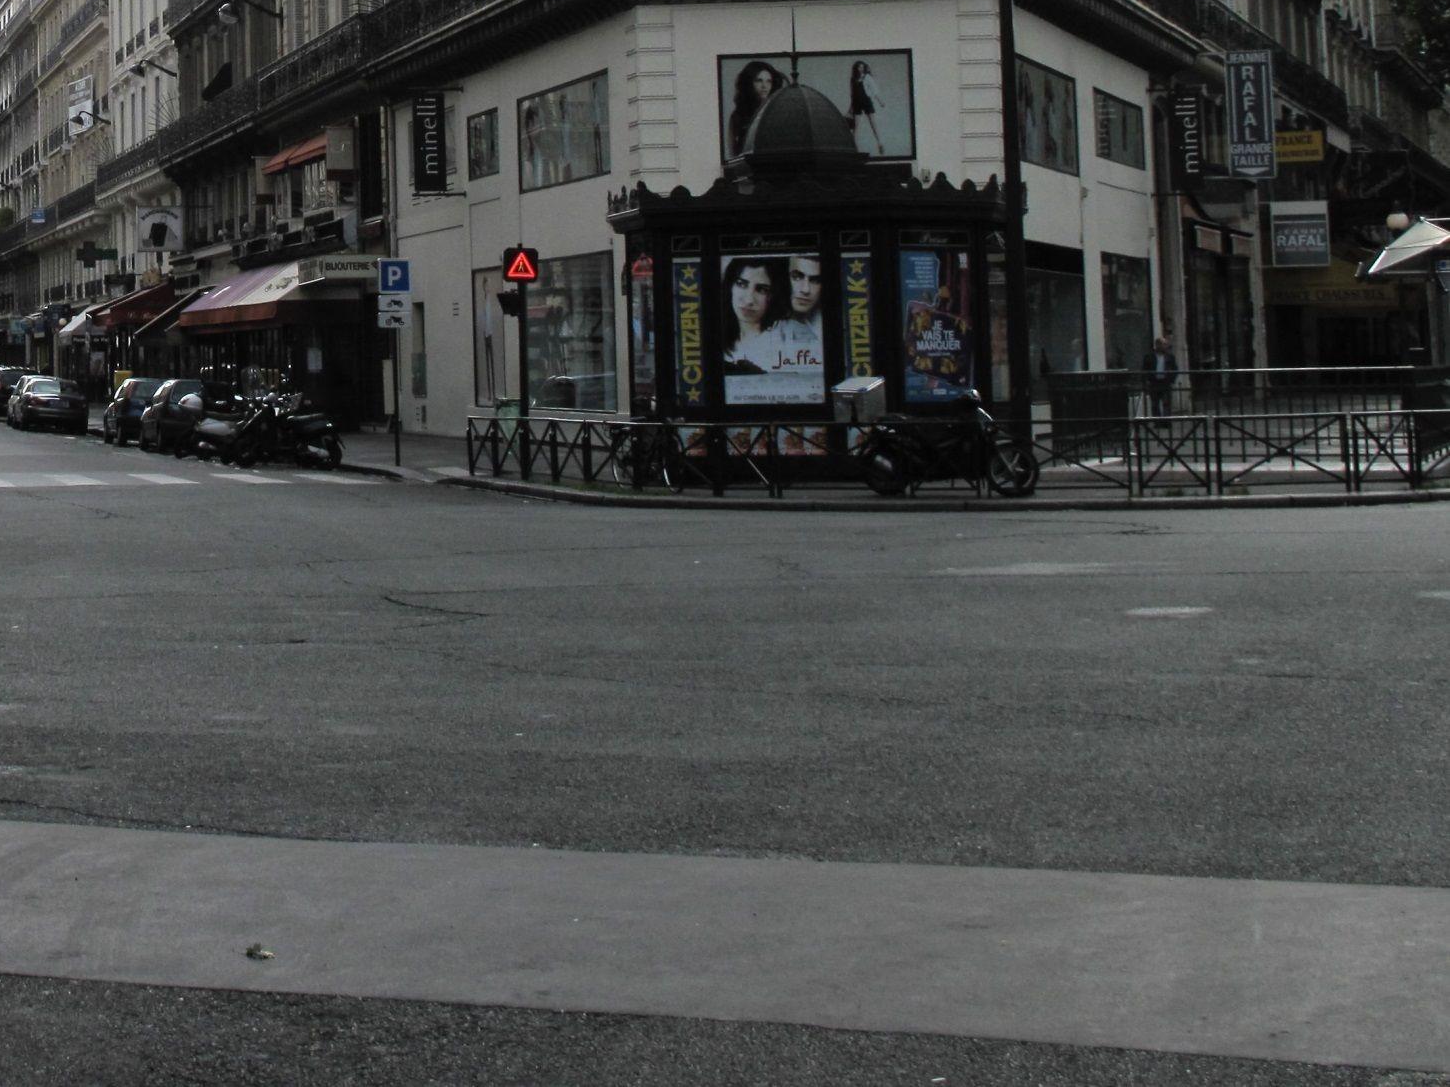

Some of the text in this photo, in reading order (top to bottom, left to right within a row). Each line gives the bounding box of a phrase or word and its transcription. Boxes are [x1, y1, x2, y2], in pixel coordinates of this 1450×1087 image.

[1227, 53, 1268, 64] JEANNE
[1241, 65, 1257, 142] RAFAL
[416, 98, 438, 174] minelli
[1174, 97, 1200, 173] minelli
[1230, 143, 1272, 154] GRANDE
[1232, 154, 1271, 166] TAILLE
[1276, 235, 1326, 247] RAFAL
[325, 262, 370, 271] BIJOUTERIE
[846, 276, 872, 377] CITIZEN K
[932, 320, 943, 331] JE
[679, 281, 703, 385] CITIZEN K
[922, 329, 955, 341] VAIS TE
[916, 340, 962, 351] MANQUER
[772, 350, 822, 369] Jaffa
